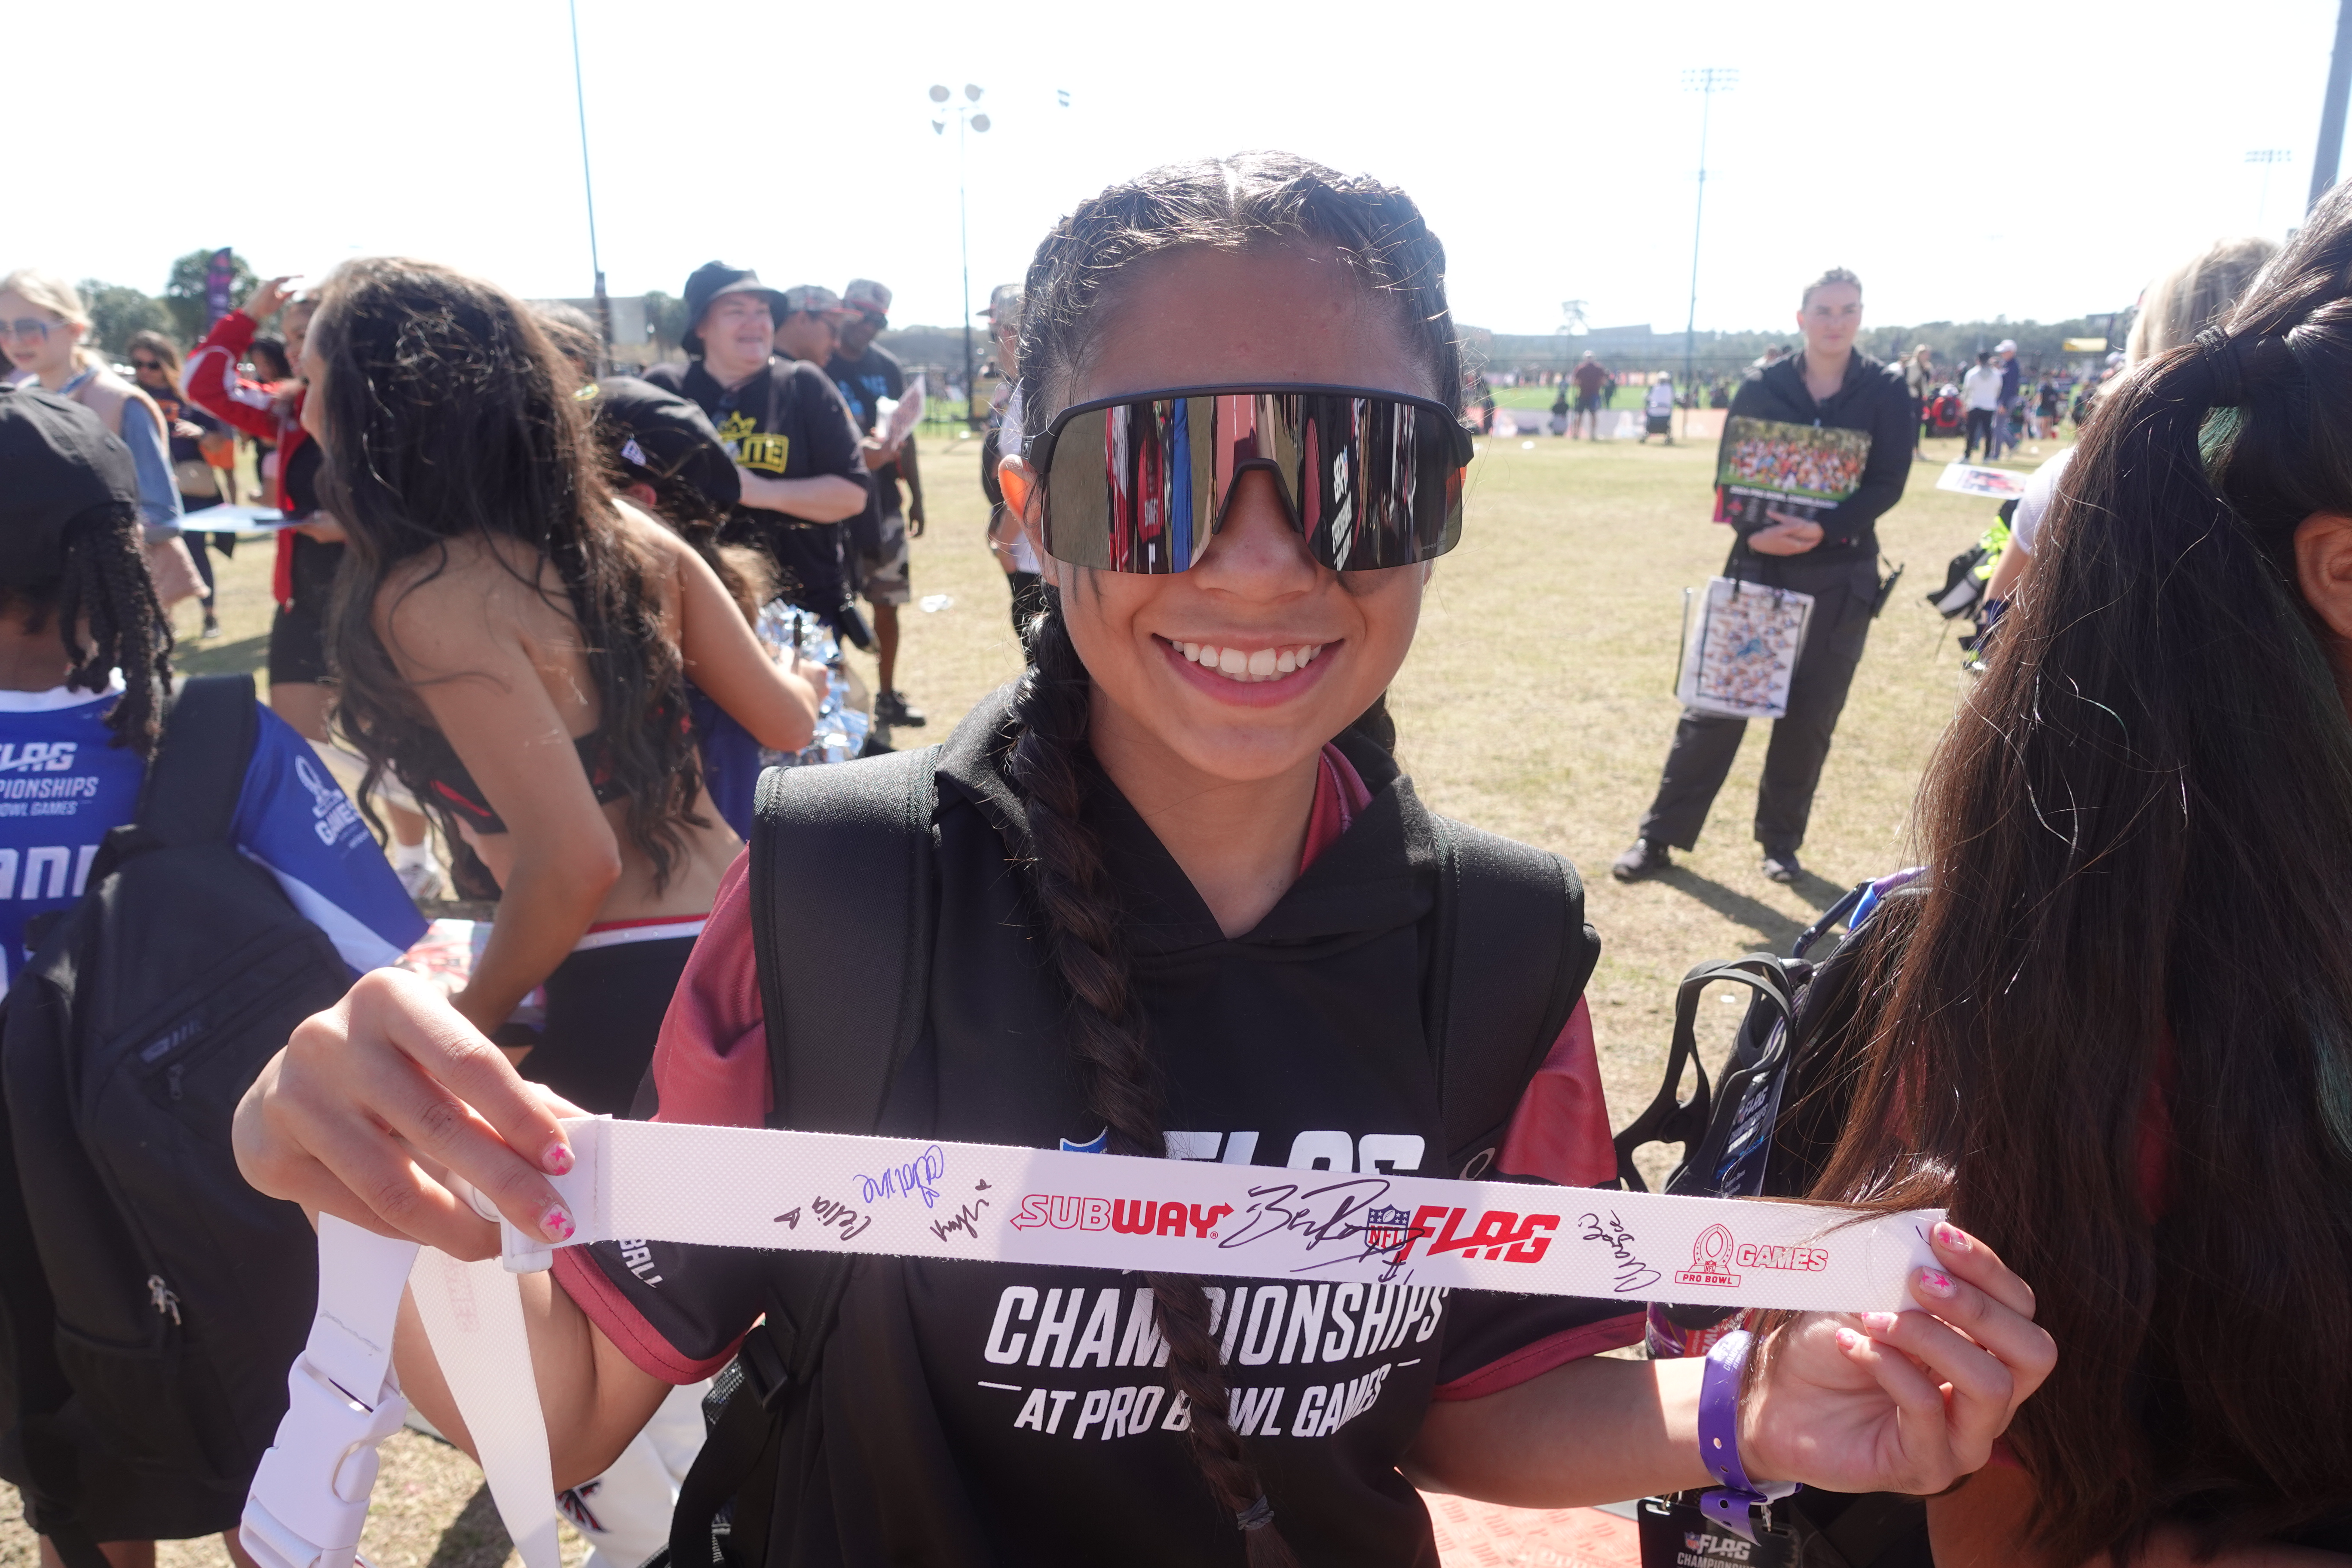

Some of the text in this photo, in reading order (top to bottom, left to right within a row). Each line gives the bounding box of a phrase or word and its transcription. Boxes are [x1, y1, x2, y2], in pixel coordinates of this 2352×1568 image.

[0, 742, 78, 772] LAG
[1010, 1193, 1234, 1239] SUBWAY
[1368, 1225, 1403, 1249] NFL
[1393, 1205, 1561, 1263] FLAG
[1736, 1243, 1828, 1271] GAMES
[1682, 1274, 1733, 1285] PRO BOWL
[1014, 1363, 1391, 1440] AT PRO BWL GAMES
[1697, 1533, 1751, 1561] FLAG
